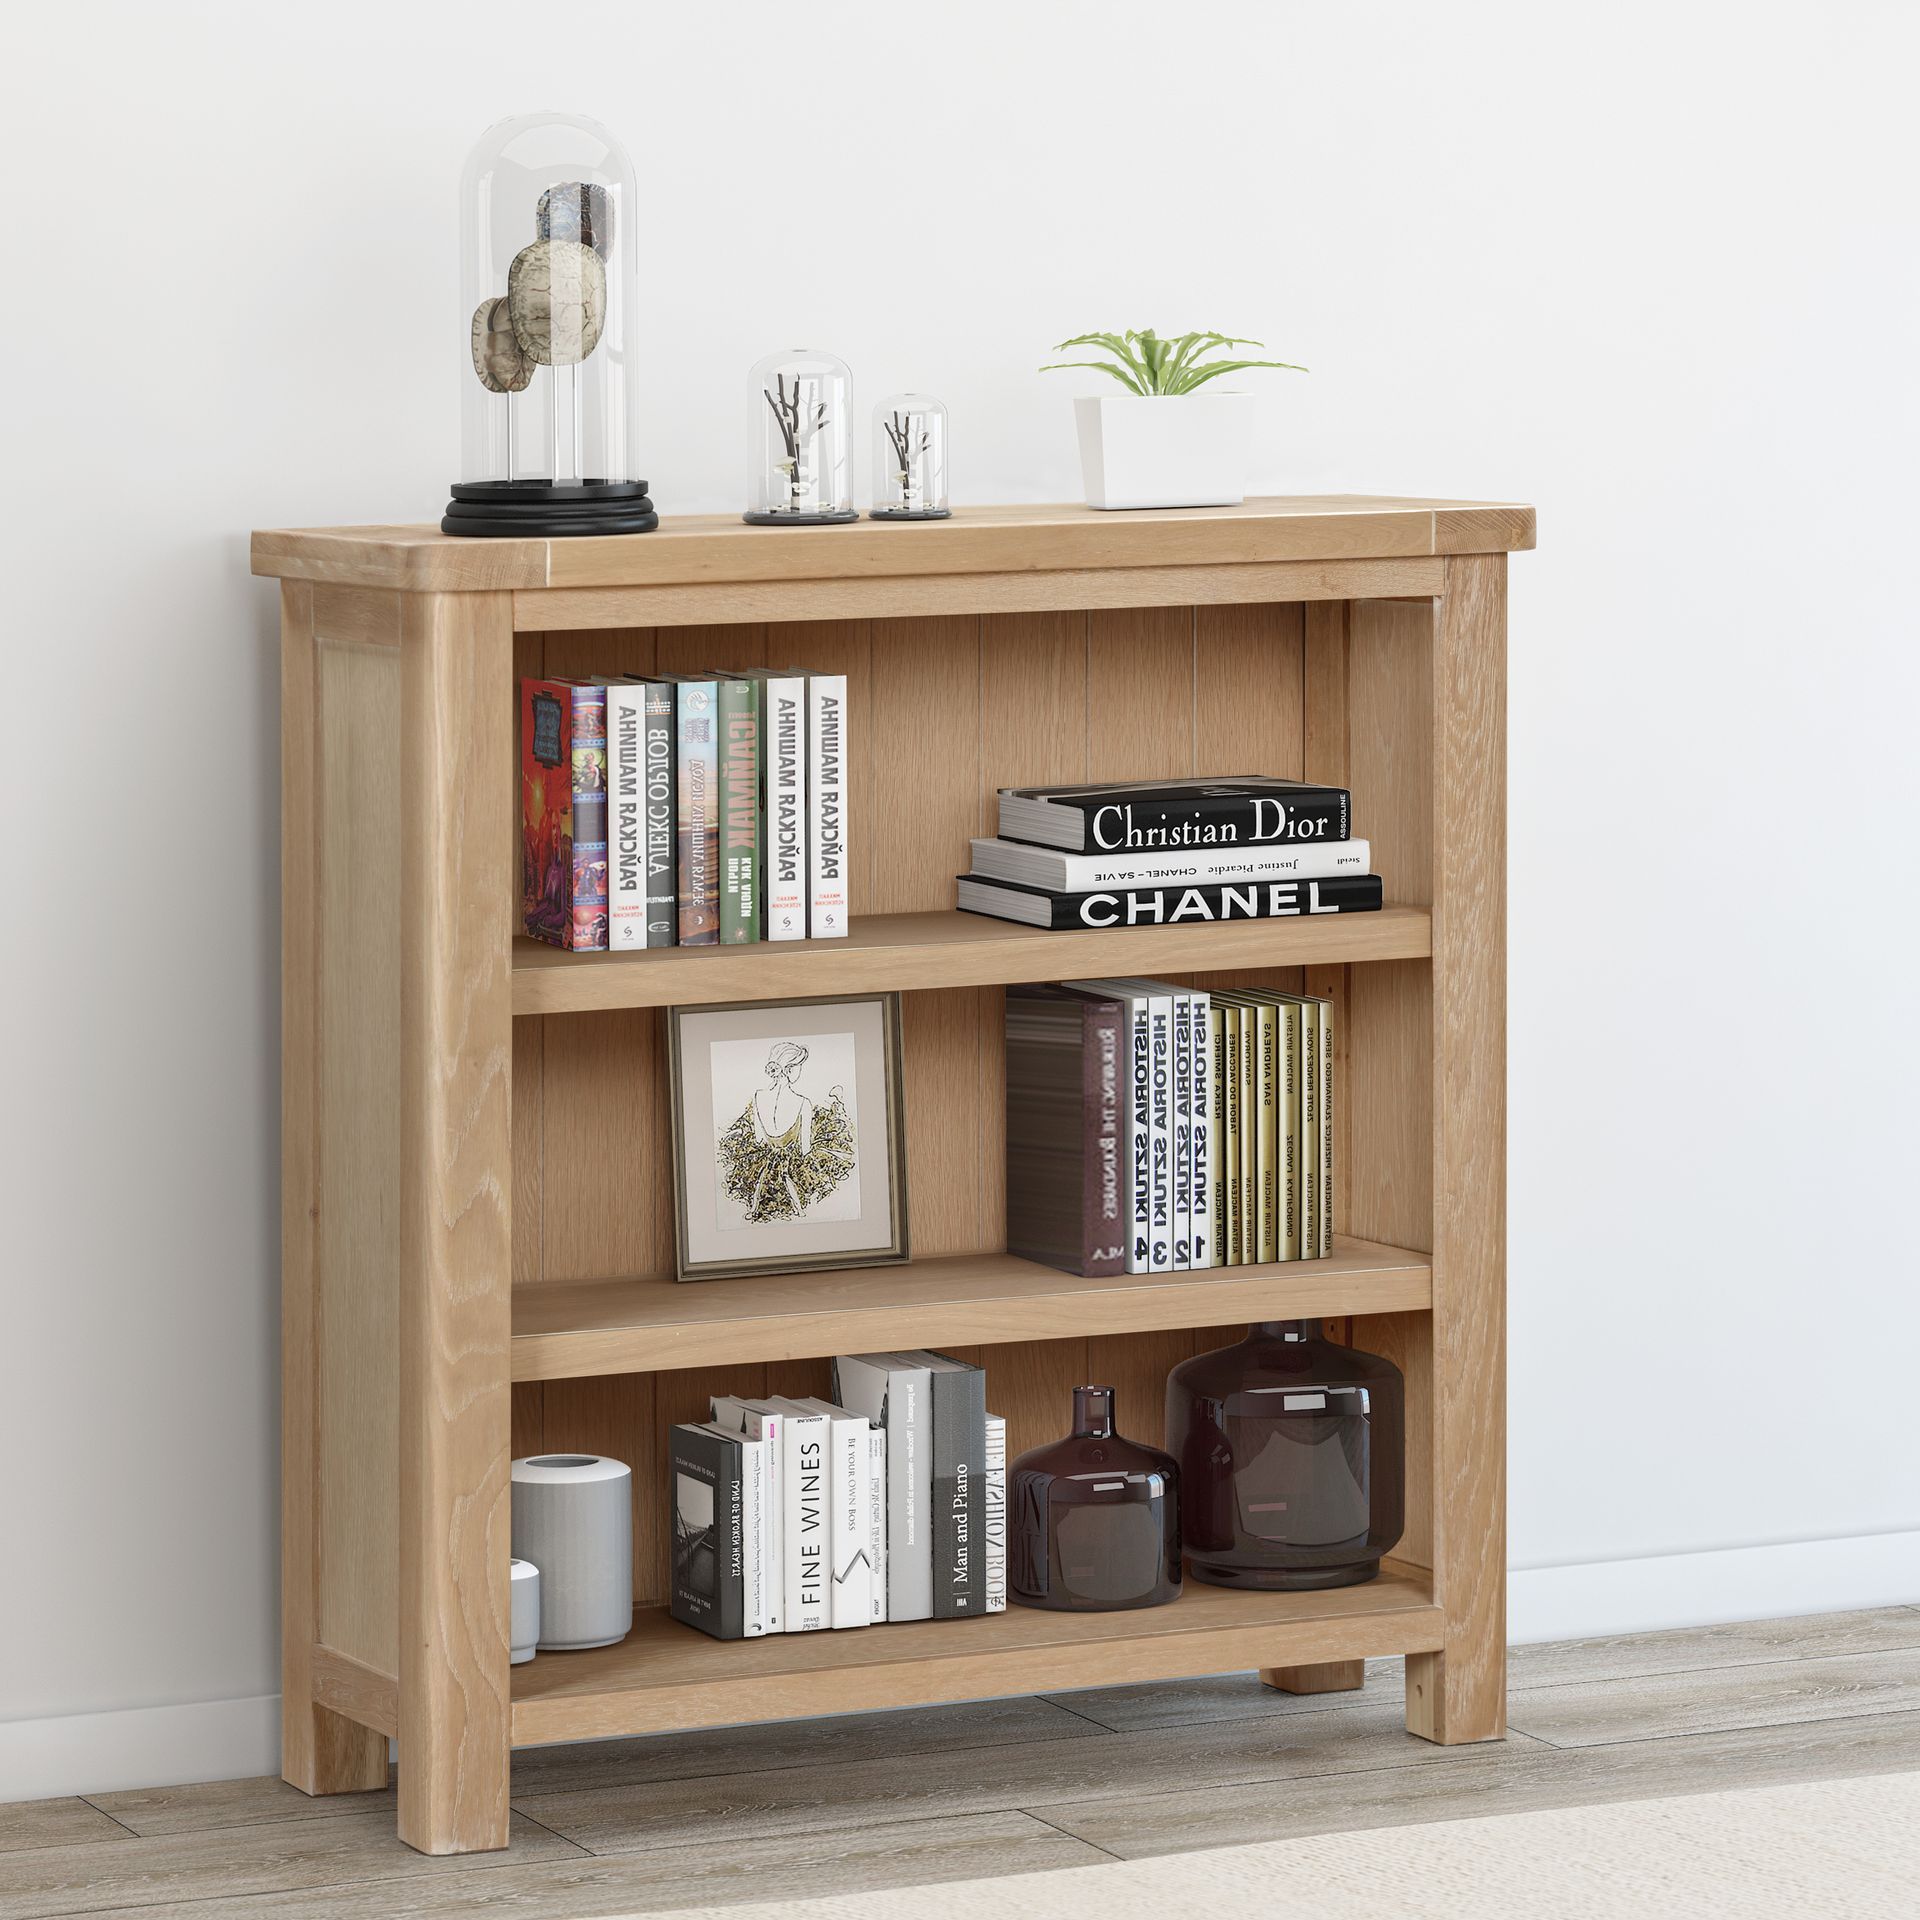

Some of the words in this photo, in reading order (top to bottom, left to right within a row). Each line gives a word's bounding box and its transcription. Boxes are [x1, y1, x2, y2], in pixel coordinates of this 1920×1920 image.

[1092, 803, 1238, 851] Christian
[1248, 797, 1330, 842] Dior
[1339, 793, 1348, 840] ASSOULINE
[1208, 862, 1255, 877] Picardie
[1258, 858, 1299, 873] Justine
[1337, 857, 1361, 866] Steidl
[1079, 881, 1340, 928] CHANEL
[800, 1442, 821, 1532] WINES
[848, 1479, 857, 1506] OWN
[953, 1463, 968, 1509] Piano
[953, 1512, 968, 1543] and
[801, 1545, 821, 1605] FINE
[953, 1547, 968, 1583] Man
